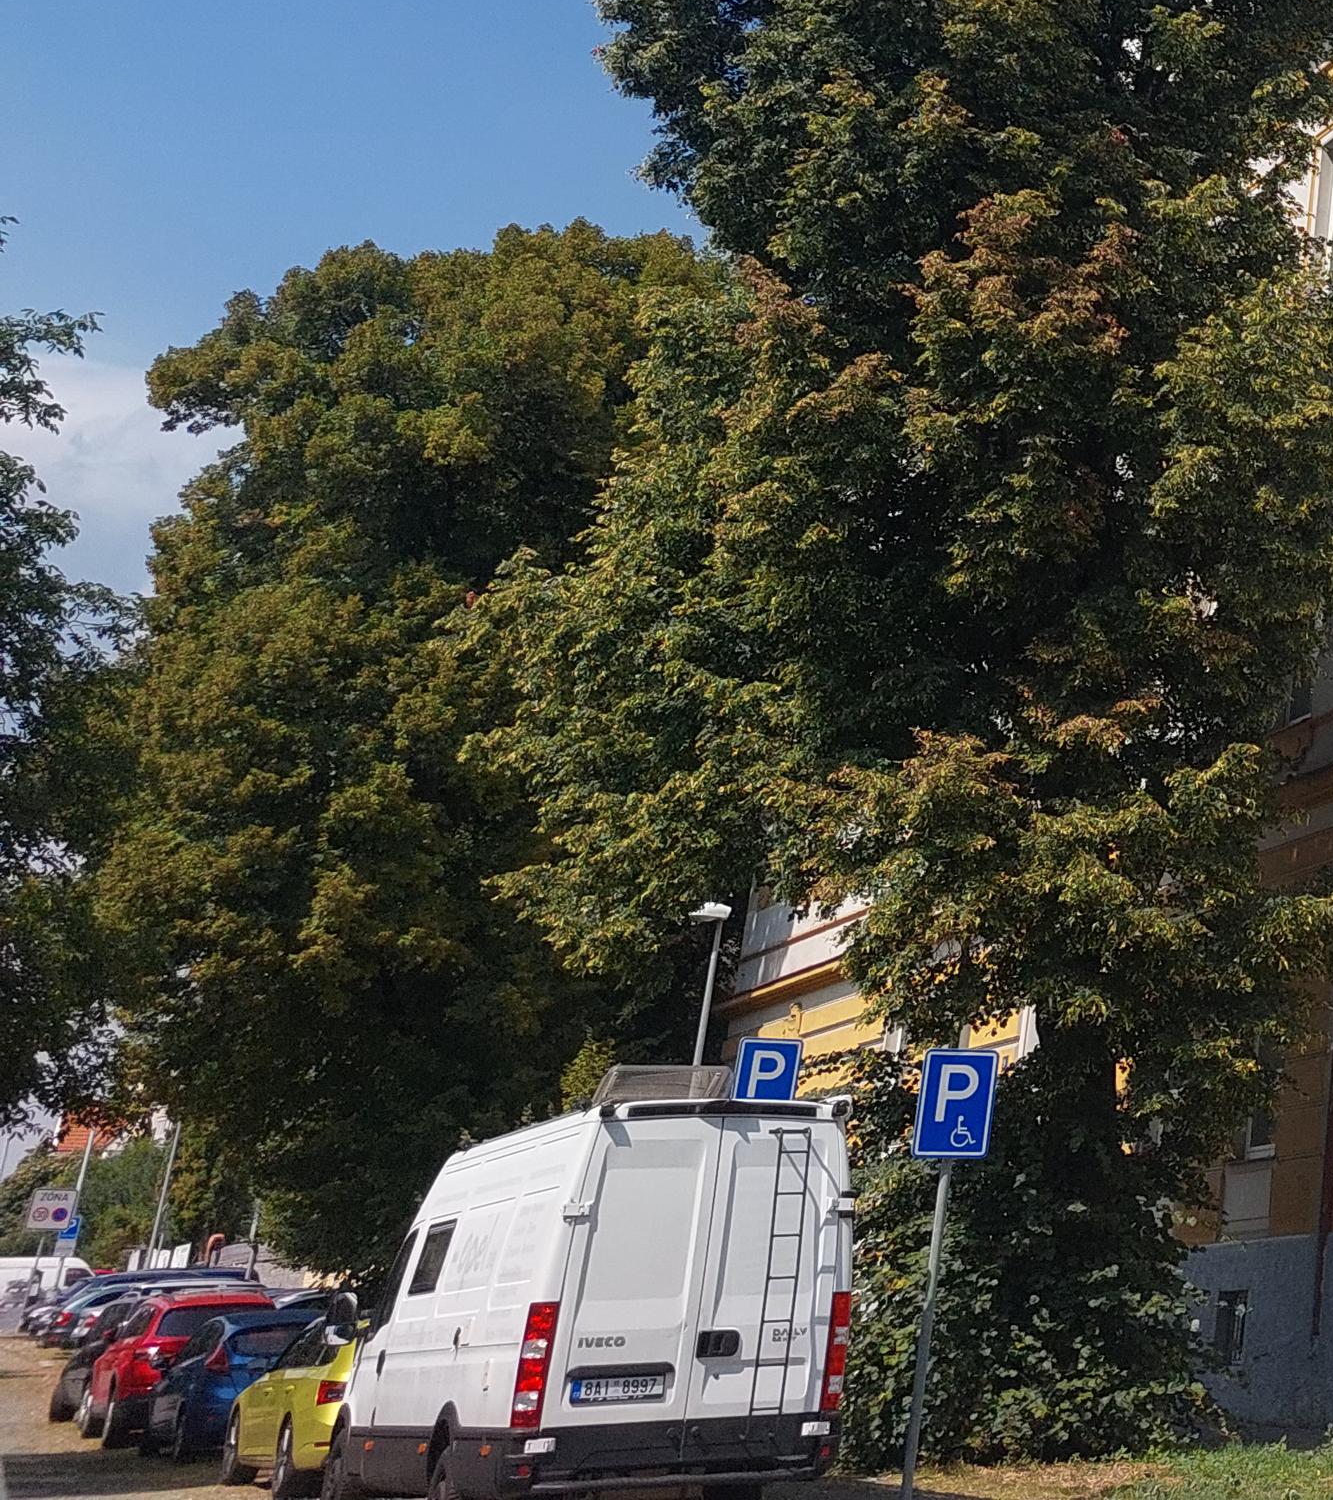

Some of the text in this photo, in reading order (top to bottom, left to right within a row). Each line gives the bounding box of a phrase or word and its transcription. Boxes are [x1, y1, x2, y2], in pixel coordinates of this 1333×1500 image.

[747, 1051, 786, 1098] P
[934, 1064, 979, 1122] P
[773, 1327, 807, 1337] DALY
[577, 1336, 626, 1349] IVECO
[622, 1378, 657, 1395] 8997
